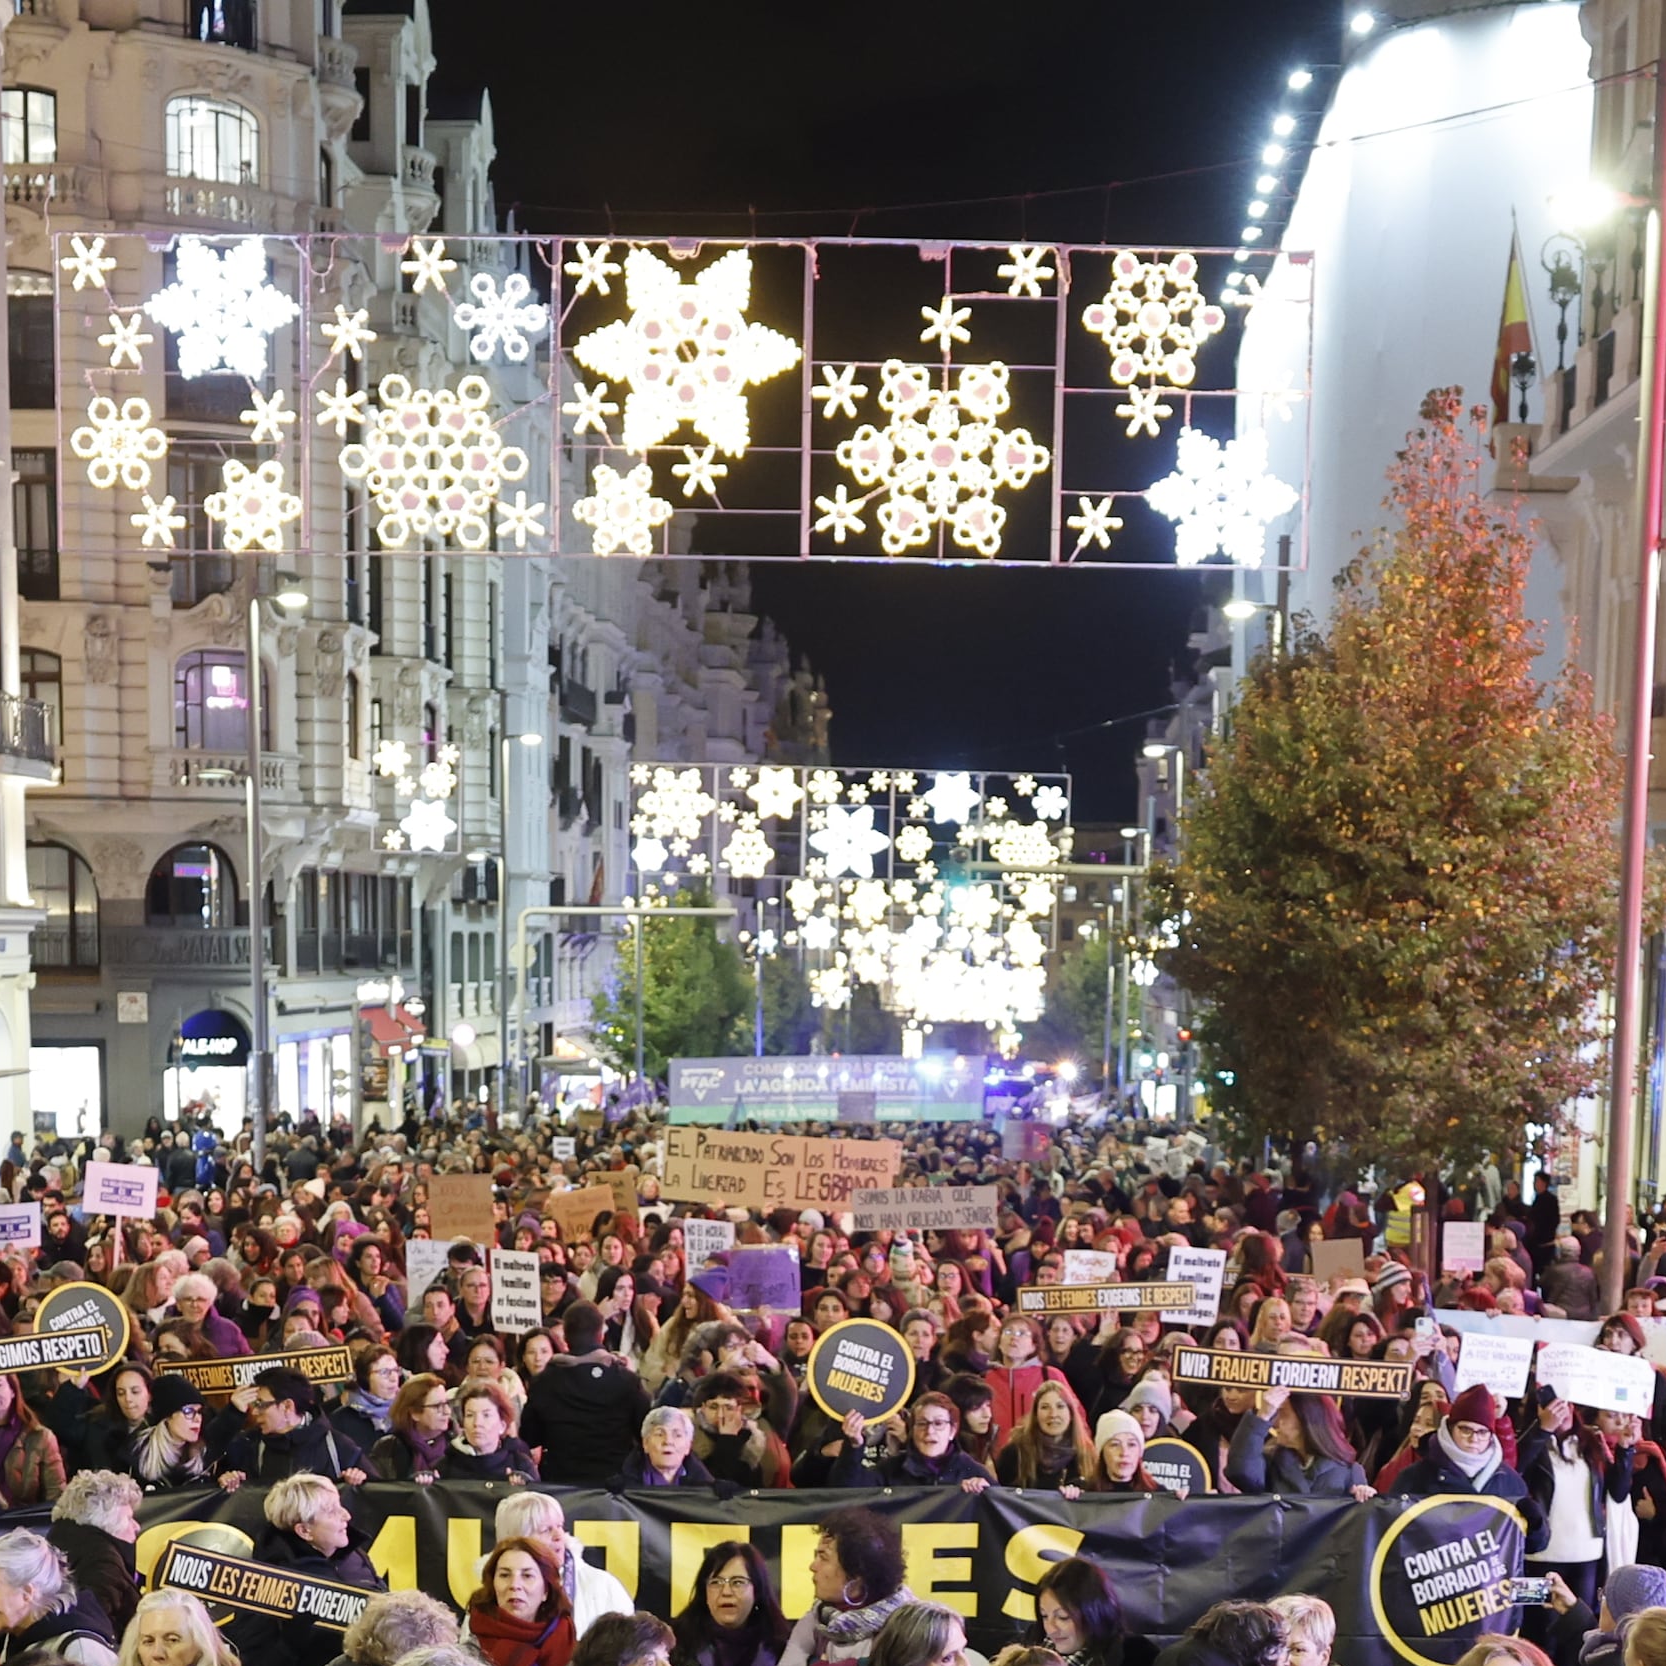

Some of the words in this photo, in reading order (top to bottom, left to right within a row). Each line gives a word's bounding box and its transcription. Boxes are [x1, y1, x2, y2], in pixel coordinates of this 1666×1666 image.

[743, 1061, 872, 1076] COMPOMTIDAS
[681, 1076, 721, 1089] PFAC
[857, 1190, 889, 1206] SOMOS
[895, 1190, 909, 1205] LA
[911, 1188, 944, 1204] RABIA
[952, 1188, 974, 1203] QUE
[854, 1213, 874, 1230] NOS
[882, 1212, 903, 1228] HAN
[907, 1209, 954, 1227] OBLIGADO
[494, 1258, 502, 1270] El
[503, 1258, 536, 1272] maltrato
[1174, 1254, 1182, 1265] El
[1183, 1256, 1221, 1268] maltrato
[501, 1276, 532, 1290] familiar
[1178, 1273, 1213, 1284] familiar
[1021, 1289, 1045, 1309] NOUS
[1045, 1289, 1060, 1308] LES
[1060, 1288, 1097, 1308] FEMMES
[1097, 1287, 1141, 1307] EXIGEONS
[1141, 1286, 1153, 1305] LE
[1153, 1285, 1194, 1305] RESPECT
[48, 1303, 87, 1331] CONTRA
[84, 1299, 99, 1316] EL
[495, 1316, 504, 1326] en
[514, 1313, 540, 1328] hogar.
[43, 1332, 103, 1363] RESPETO
[838, 1338, 881, 1367] CONTRA
[879, 1351, 895, 1370] EL
[197, 1365, 234, 1388] FEMMES
[299, 1351, 347, 1379] RESPECT
[832, 1354, 881, 1381] BORRADO
[1180, 1353, 1210, 1379] WIR
[1211, 1356, 1271, 1385] FRAUEN
[1270, 1361, 1340, 1389] FORDERN
[1340, 1366, 1407, 1393] RESPEKT
[826, 1374, 886, 1404] MUJERES
[1179, 1464, 1192, 1480] EL
[1404, 1537, 1478, 1580] CONTRA
[1474, 1528, 1501, 1555] EL
[1410, 1559, 1492, 1606] BORRADO
[1490, 1554, 1502, 1568] DE
[1492, 1563, 1508, 1579] LAS
[169, 1553, 210, 1589] NOUS
[208, 1564, 239, 1596] LES
[237, 1569, 300, 1612] FEMMES
[297, 1582, 367, 1624] EXIGEONS
[1419, 1578, 1514, 1637] MUJERES
